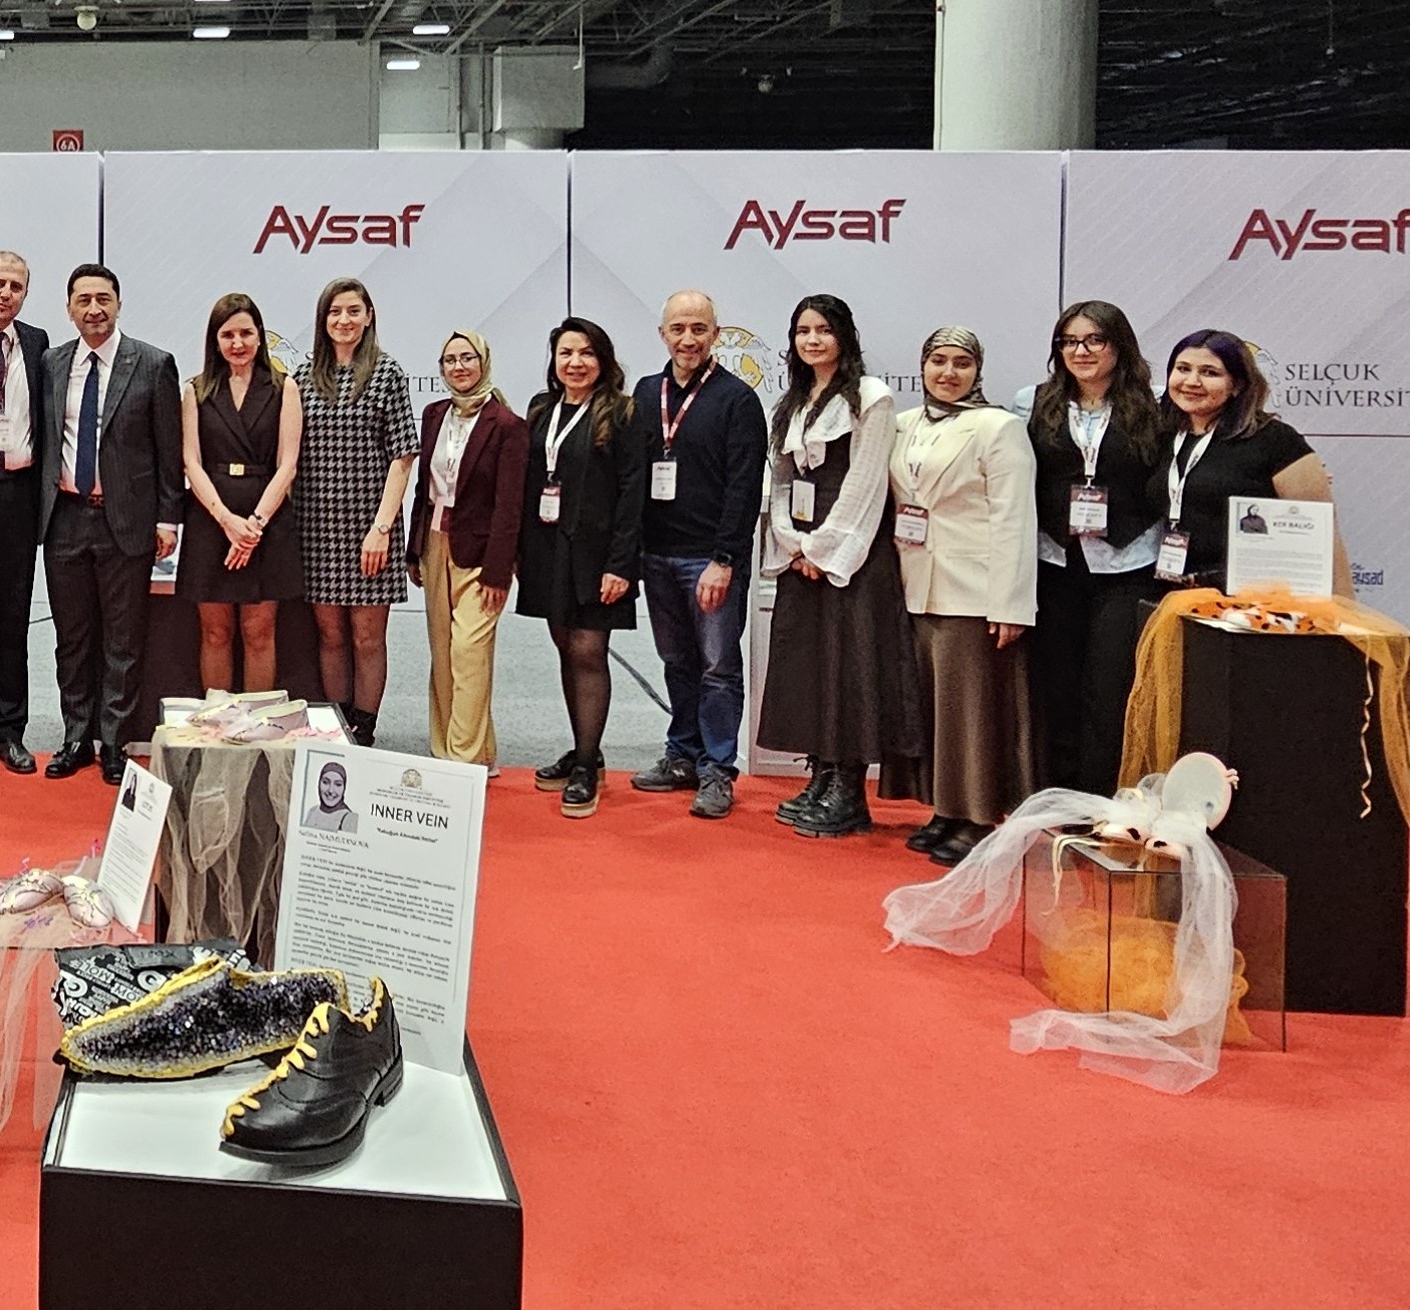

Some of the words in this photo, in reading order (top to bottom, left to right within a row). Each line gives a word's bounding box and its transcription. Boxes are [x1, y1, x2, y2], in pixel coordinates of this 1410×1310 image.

[60, 139, 76, 151] 6A
[253, 204, 425, 254] Aysaf
[723, 199, 906, 250] Aysaf
[1285, 363, 1381, 386] SELÇUK
[370, 803, 413, 823] INNER
[416, 811, 449, 829] VEIN
